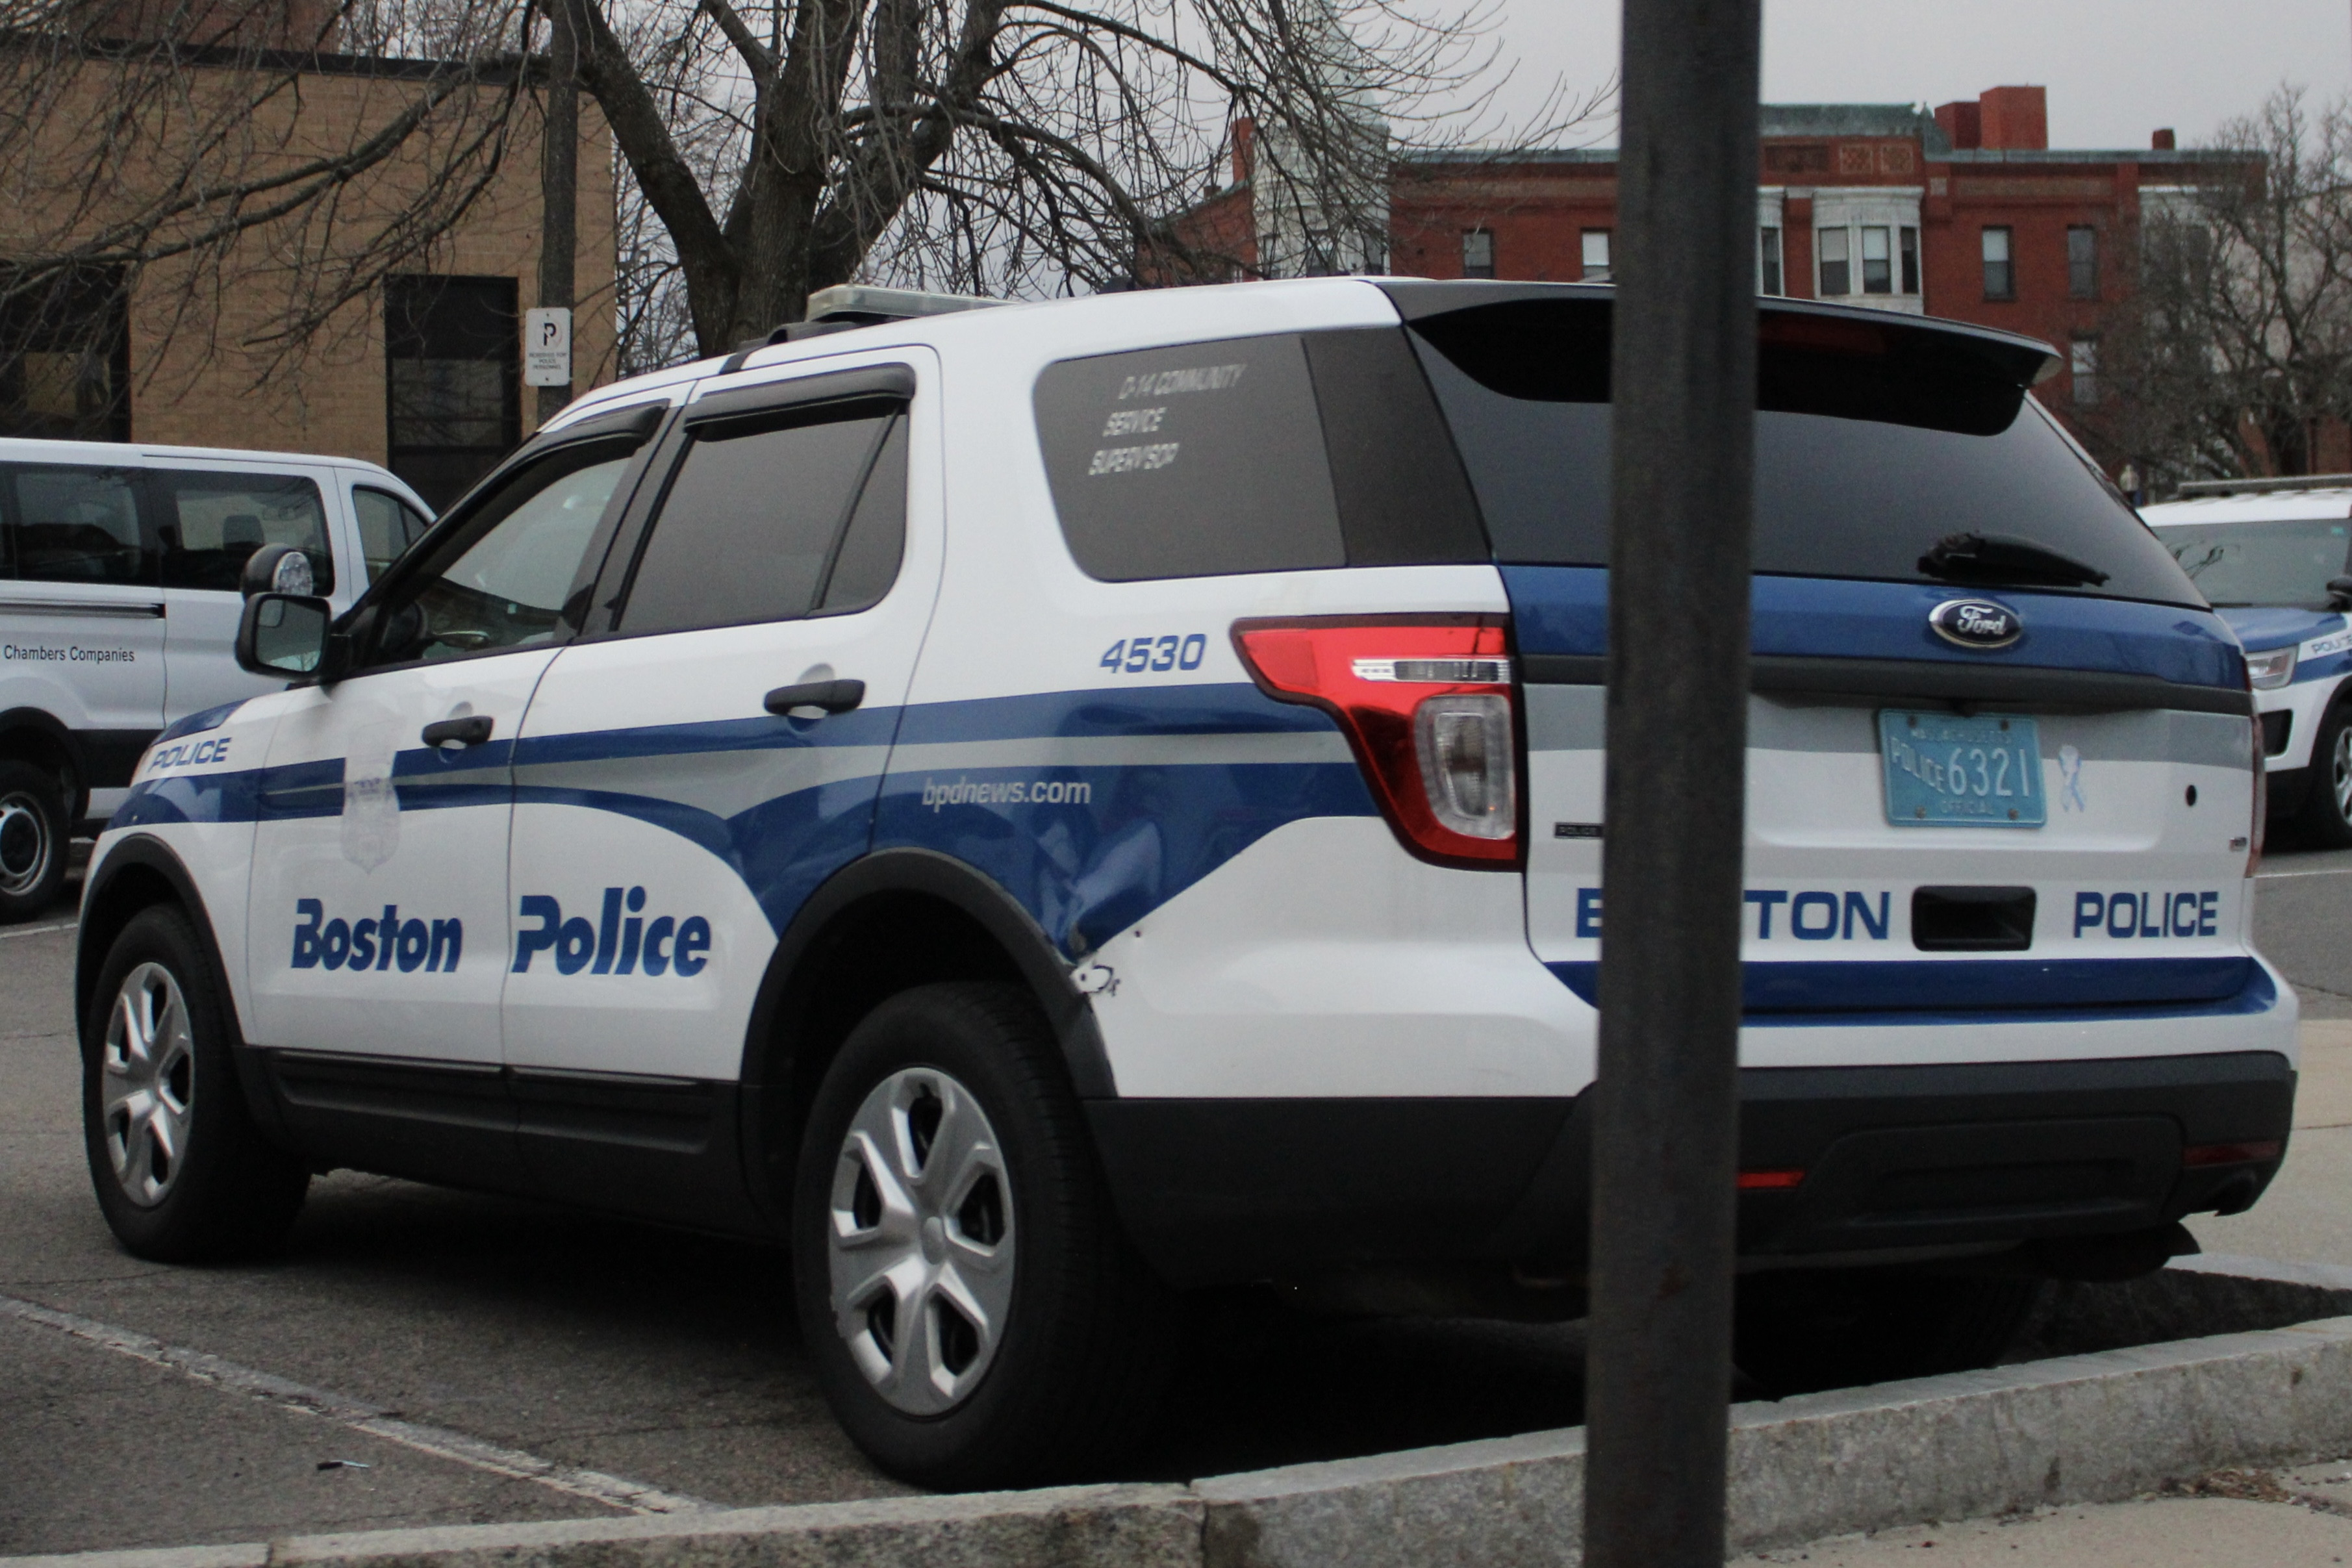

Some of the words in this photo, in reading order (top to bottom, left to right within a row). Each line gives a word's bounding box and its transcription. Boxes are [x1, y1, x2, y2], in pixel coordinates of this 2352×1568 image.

[1957, 605, 2007, 635] Ford
[4, 645, 66, 661] Chambers
[70, 646, 135, 664] Companies
[1099, 633, 1207, 674] 4530
[148, 737, 233, 772] POLICE
[1949, 747, 2030, 798] 6321
[921, 776, 1093, 814] bpdnews.com
[291, 898, 462, 973] Boston
[512, 885, 712, 978] Police
[2073, 891, 2219, 939] POLICE
